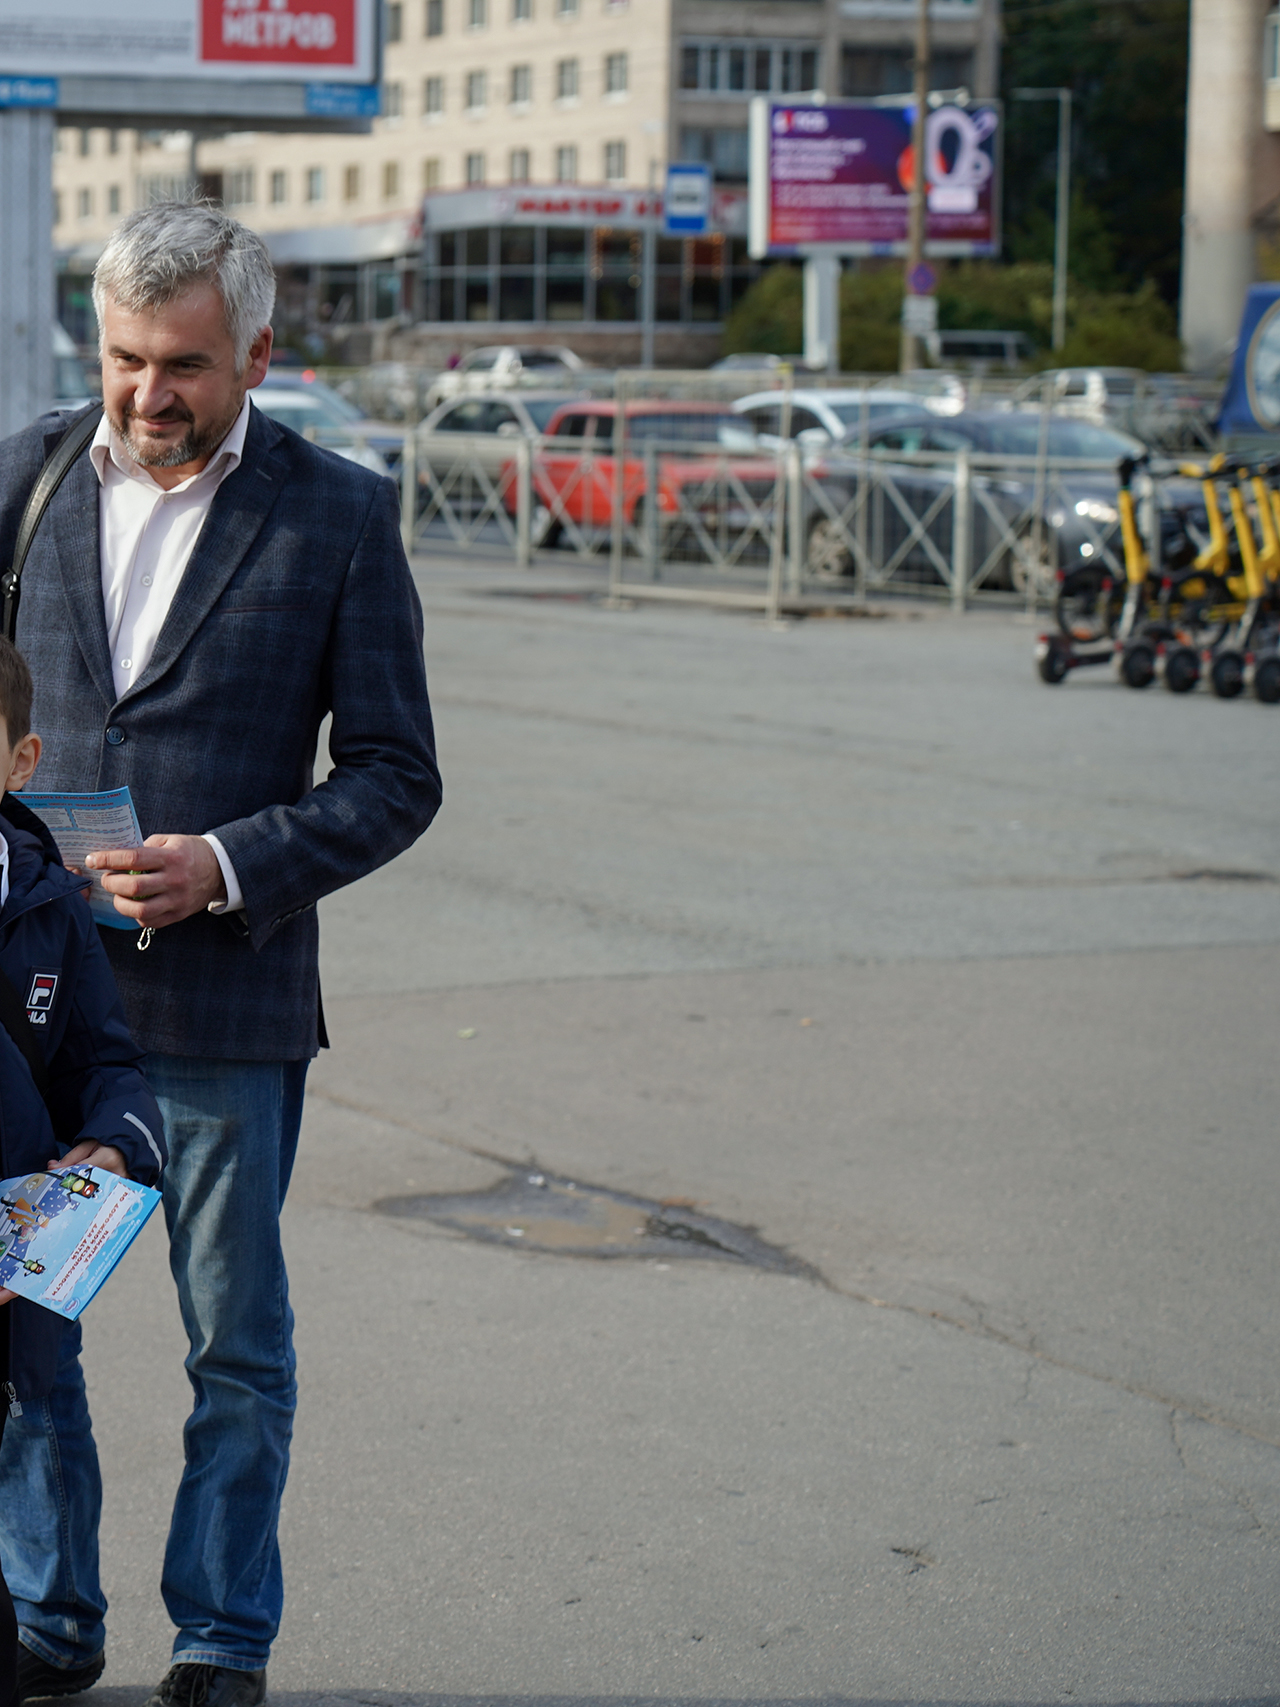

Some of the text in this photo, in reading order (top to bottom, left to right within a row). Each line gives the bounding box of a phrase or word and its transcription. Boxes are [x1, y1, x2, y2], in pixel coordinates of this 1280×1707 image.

[221, 11, 337, 49] МЕТРОВ
[118, 1191, 128, 1202] ПО
[70, 1223, 98, 1260] ДЛЯ ДЕТЕЙ
[88, 1203, 120, 1244] ДОРОЖНОЙ
[83, 1229, 109, 1263] ПАМЯТКА
[51, 1244, 90, 1297] БЕЗОПАСНОСТИ
